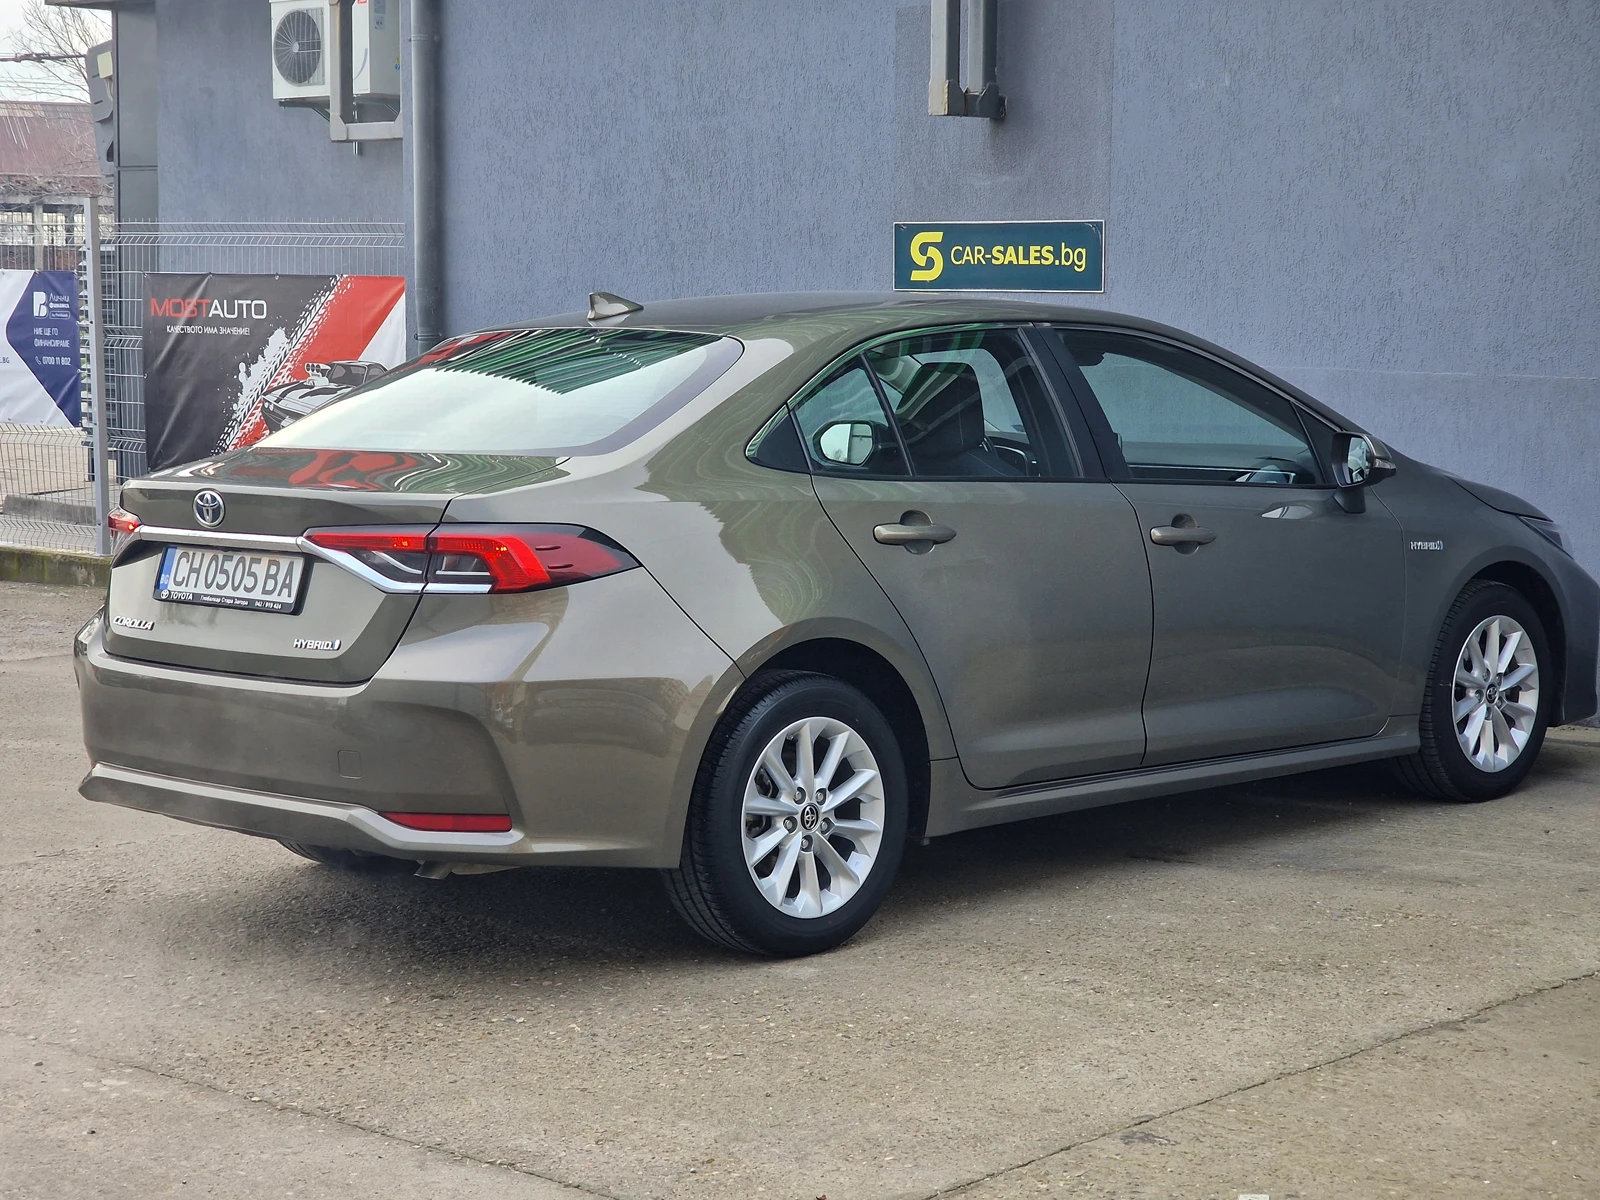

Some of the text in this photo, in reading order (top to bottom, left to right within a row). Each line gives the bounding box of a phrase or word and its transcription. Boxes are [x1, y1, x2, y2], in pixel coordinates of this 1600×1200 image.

[951, 242, 1087, 272] CAR-SALES.bg
[50, 292, 70, 302] Лични
[150, 298, 267, 319] MOSTAUTO
[33, 327, 59, 336] НИЕ ЩЕ ГО
[166, 325, 203, 334] КАЧЕСТВОТО
[204, 326, 218, 334] ИМА
[33, 338, 70, 348] ФИНАНСИРАМЕ
[42, 356, 71, 366] 0700 11 802
[1410, 541, 1438, 550] HYBRID
[160, 573, 170, 585] BG
[170, 591, 193, 601] TOYOTA
[113, 616, 155, 631] COROLLA
[293, 639, 333, 650] HYBRID
